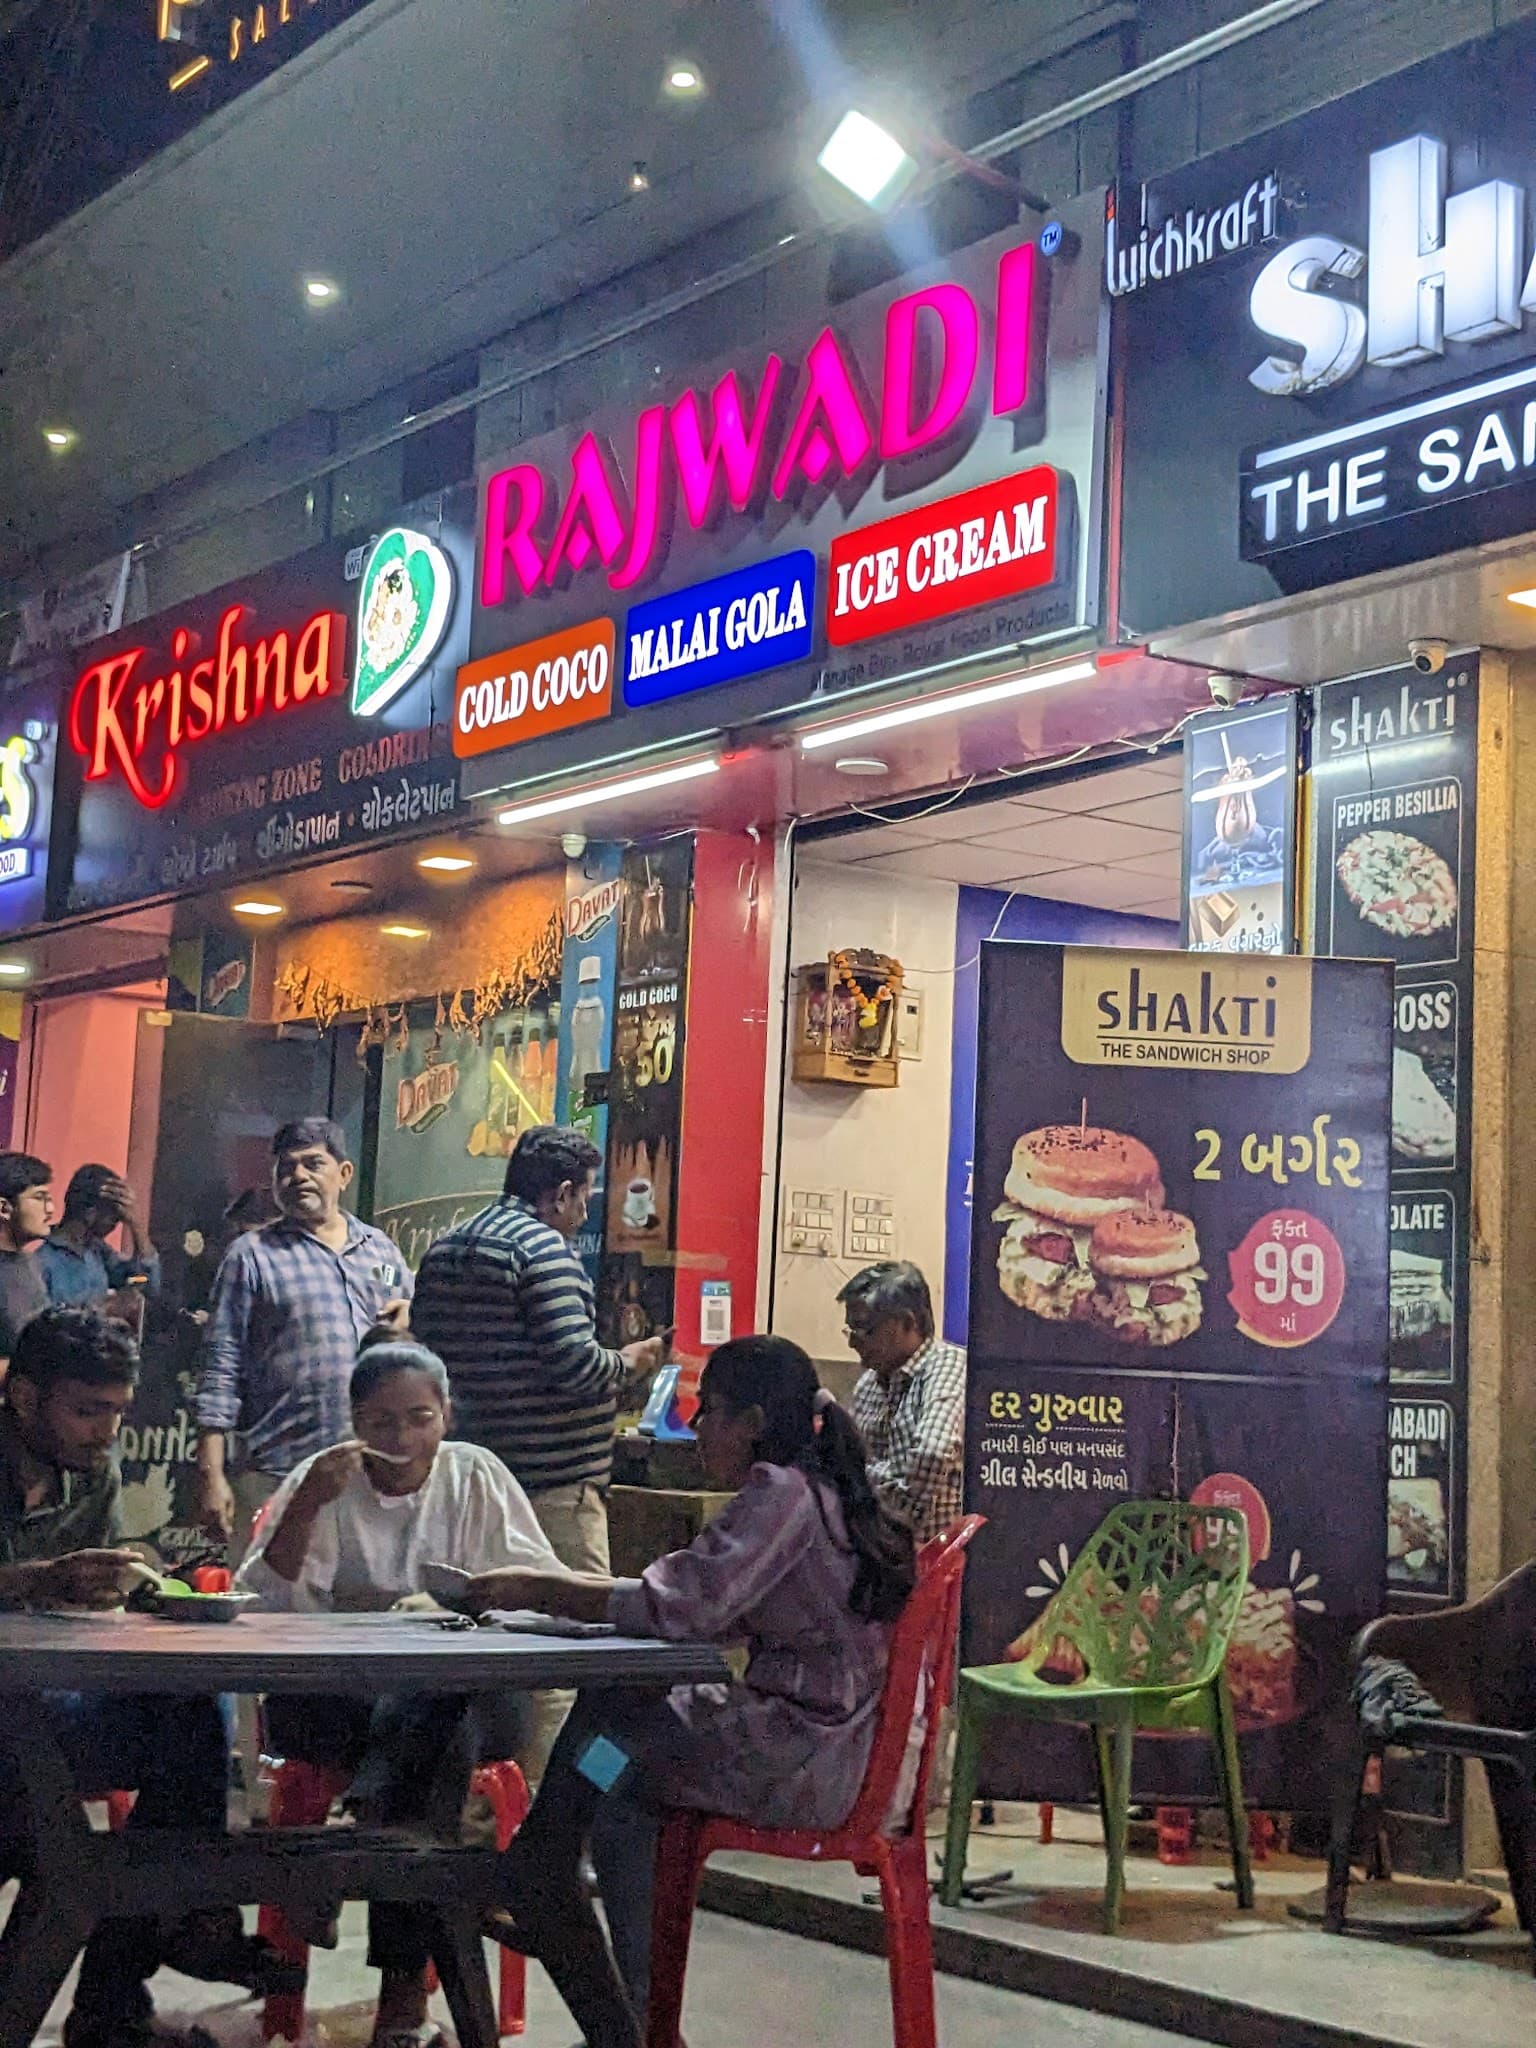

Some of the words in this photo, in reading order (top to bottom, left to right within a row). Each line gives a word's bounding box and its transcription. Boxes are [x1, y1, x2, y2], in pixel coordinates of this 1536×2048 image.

[480, 242, 1036, 608] RAJWADI
[1251, 446, 1388, 542] THE
[834, 547, 900, 617] ICE
[906, 495, 1048, 593] CREAM
[628, 607, 721, 682] MALAI
[725, 579, 807, 650] GOLA
[995, 601, 1070, 635] Products
[69, 605, 333, 808] Krishna
[458, 670, 529, 734] COLD
[531, 644, 609, 712] COCO
[271, 757, 322, 802] ZONE
[1337, 797, 1391, 830] PEPPER
[1395, 785, 1458, 819] BESILLIA
[1394, 991, 1451, 1033] OSS
[1101, 1042, 1132, 1059] THE
[1136, 1044, 1222, 1063] SANDWICH
[1226, 1048, 1271, 1065] SHOP
[1193, 1128, 1222, 1181] 2
[1240, 1114, 1363, 1188] બર્ગર
[1254, 1241, 1325, 1307] 99
[989, 1391, 1022, 1419] દર
[1028, 1392, 1125, 1433] ગુરુવાર
[1389, 1406, 1446, 1440] ABADI
[981, 1434, 1019, 1453] તમારી
[1050, 1441, 1073, 1456] પણ
[980, 1458, 1018, 1487] ગ્રીલ
